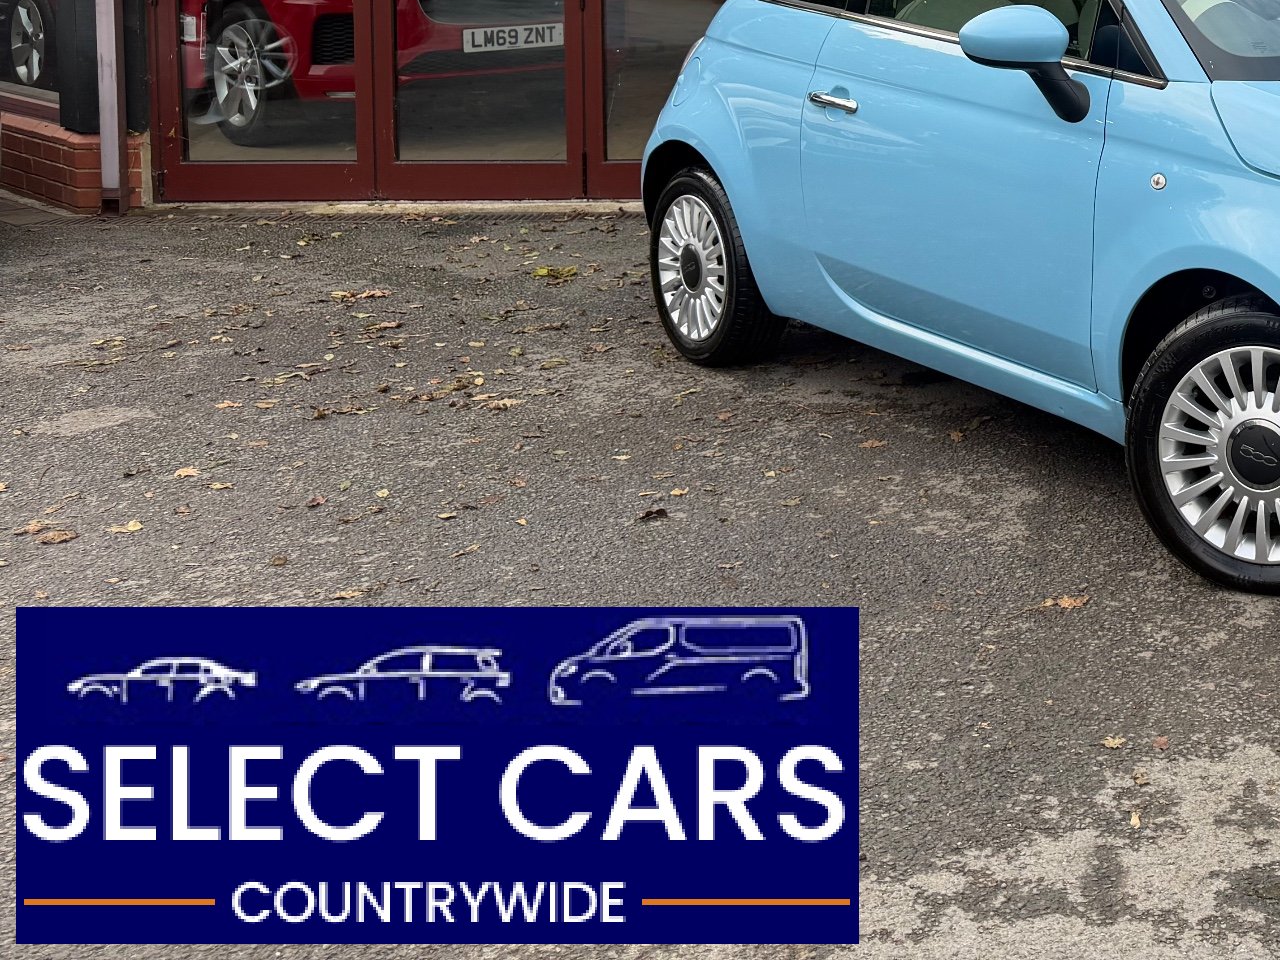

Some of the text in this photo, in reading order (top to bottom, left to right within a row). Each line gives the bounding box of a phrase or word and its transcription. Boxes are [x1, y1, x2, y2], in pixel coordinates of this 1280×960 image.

[471, 25, 556, 49] LM69 ZNT
[1239, 444, 1278, 466] 500
